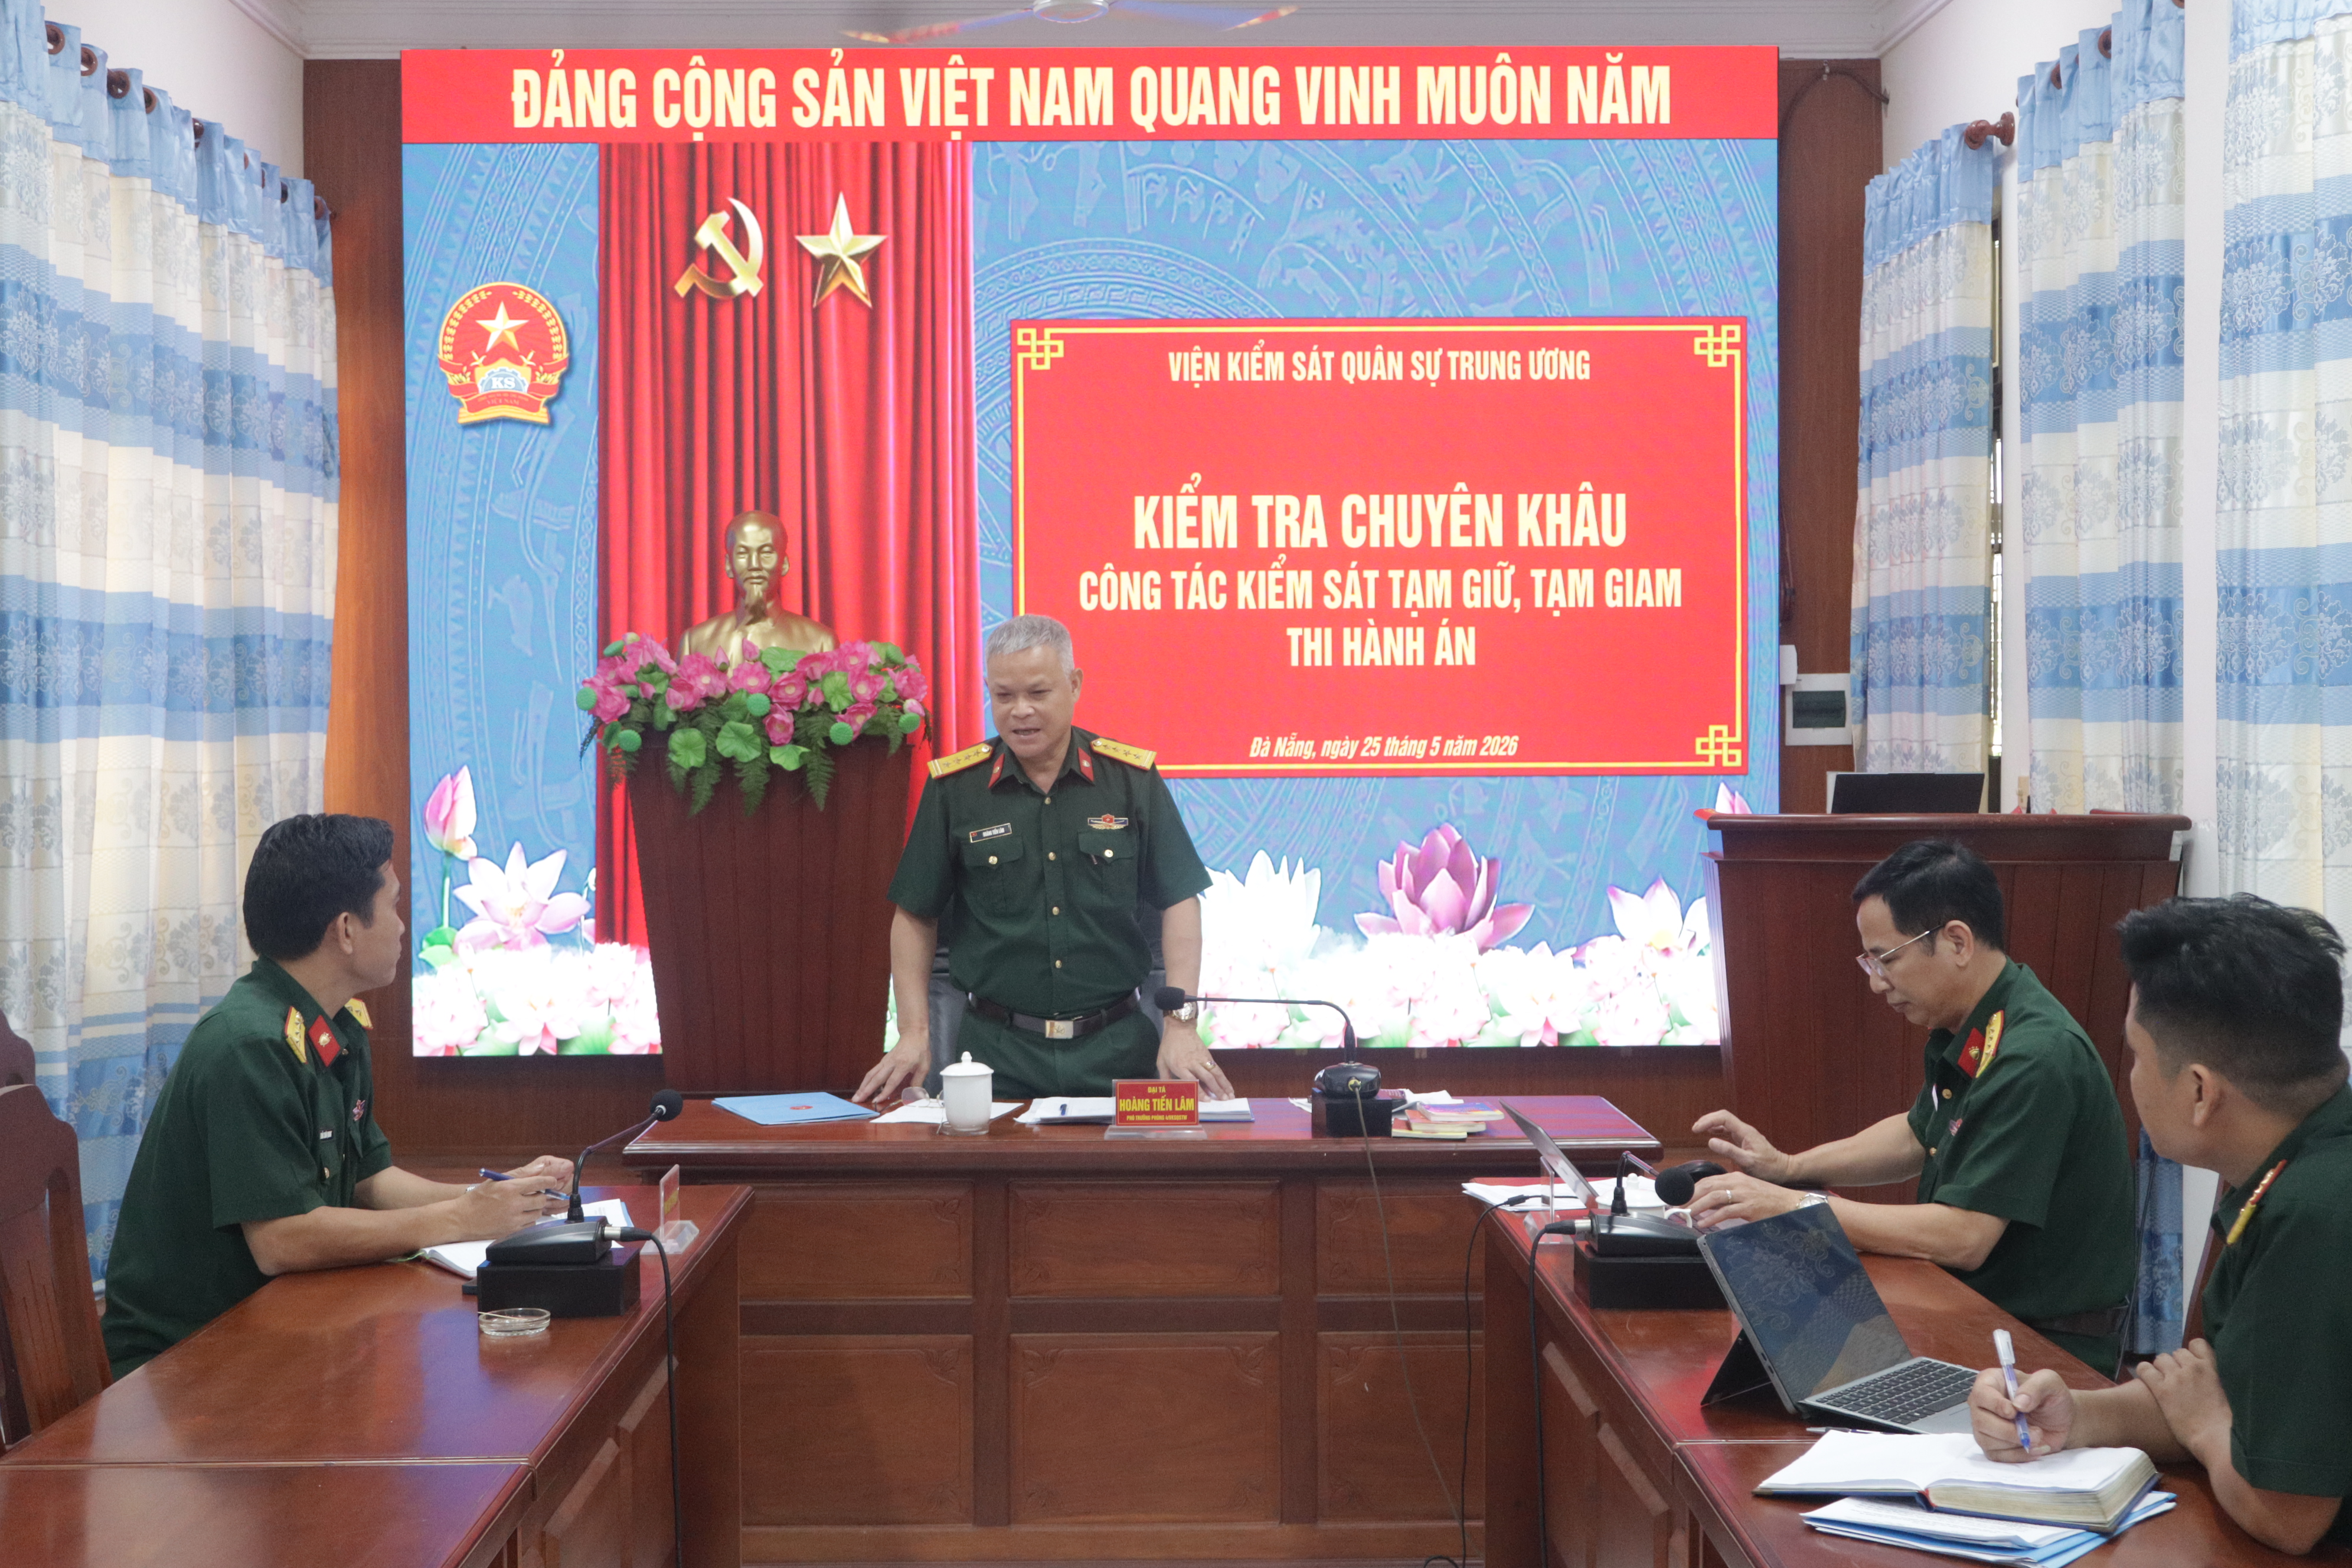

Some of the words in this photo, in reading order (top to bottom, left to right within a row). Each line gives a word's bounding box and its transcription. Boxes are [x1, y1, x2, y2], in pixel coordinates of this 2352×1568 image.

[511, 48, 637, 129] ĐẢNG
[653, 55, 776, 141] CỘNG
[792, 48, 885, 128] SẢN
[899, 54, 995, 140] VIỆT
[1010, 67, 1113, 126] NAM
[1130, 66, 1280, 133] QUANG
[1295, 66, 1400, 125] VINH
[1417, 52, 1551, 125] MUÔN
[1567, 52, 1671, 124] NĂM
[491, 377, 516, 389] KS
[1168, 345, 1220, 388] VIỆN
[1227, 339, 1285, 381] KIỂM
[1292, 344, 1335, 381] SÁT
[1341, 344, 1403, 384] QUÂN
[1410, 347, 1443, 387] SỰ
[1446, 350, 1521, 381] TRUNG
[1528, 347, 1590, 380] ƯƠNG
[1134, 472, 1238, 549] KIỂM
[1251, 494, 1328, 549] TRA
[1341, 482, 1503, 548] CHUYÊN
[1518, 481, 1626, 547] KHÂU
[1079, 562, 1161, 611] CÔNG
[1170, 561, 1227, 610] TÁC
[1237, 553, 1313, 609] KIỂM
[1323, 561, 1380, 609] SÁT
[1387, 569, 1452, 617] TẠM
[1462, 561, 1521, 613] GIỮ,
[1530, 569, 1594, 617] TẠM
[1605, 567, 1681, 608] GIAM
[1286, 627, 1332, 667] THI
[1342, 618, 1425, 667] HÀNH
[1434, 618, 1476, 666] ÁN
[1249, 736, 1271, 757] Đà
[1273, 732, 1317, 760] Nẵng,
[1320, 736, 1359, 760] ngày
[1360, 737, 1382, 757] 25
[1384, 735, 1427, 759] tháng
[1429, 736, 1442, 756] 5
[1443, 735, 1477, 756] năm
[1479, 735, 1520, 756] 2026
[1119, 1096, 1151, 1112] HOÀNG
[1152, 1095, 1172, 1111] TIẾN
[1175, 1096, 1195, 1111] LÂM
[1148, 1086, 1158, 1095] ĐẠI
